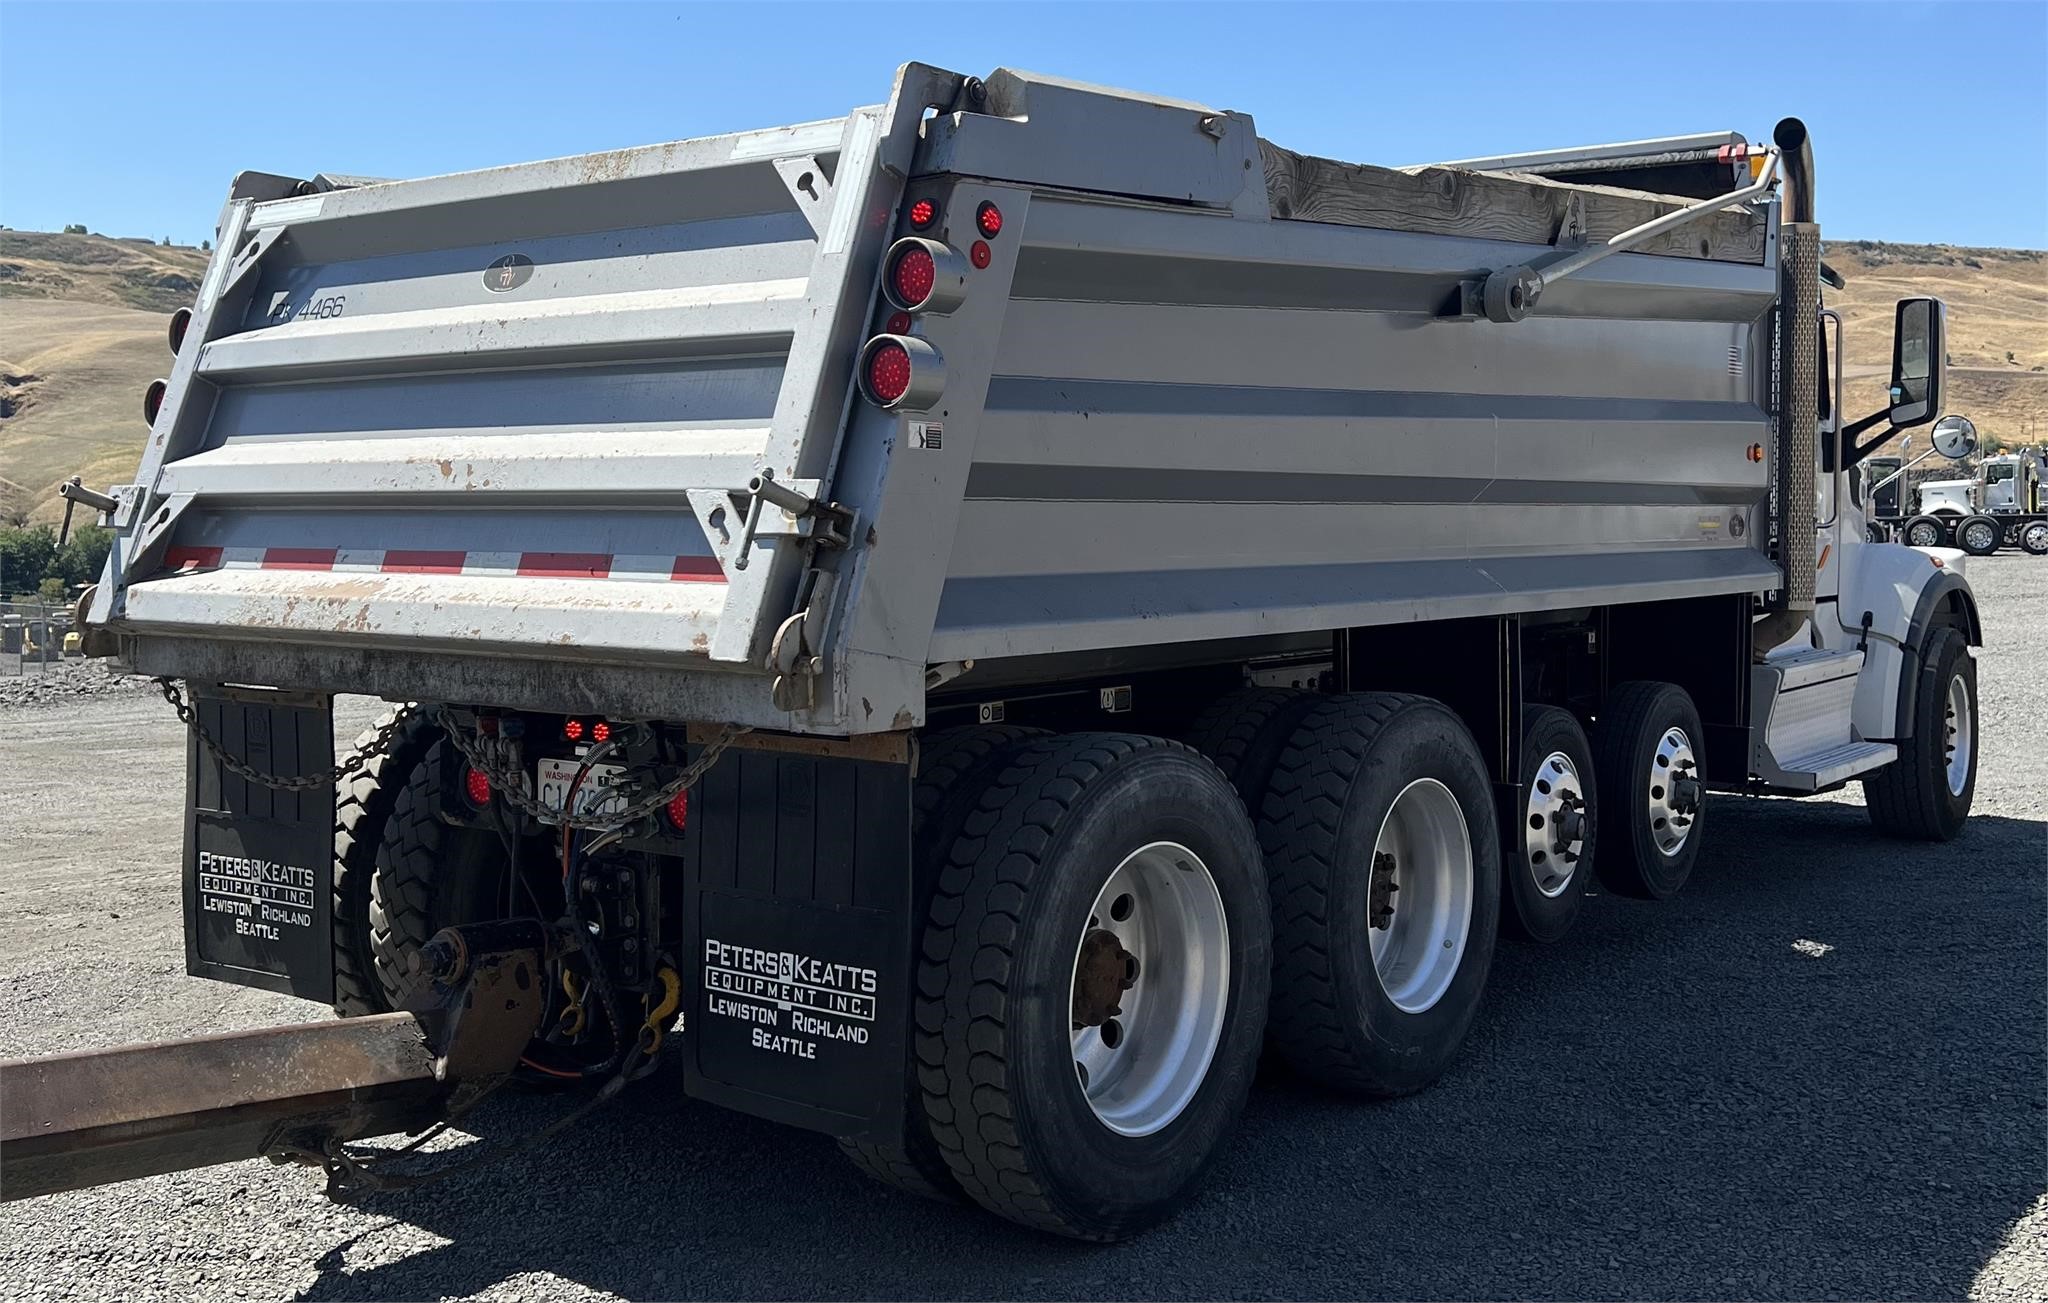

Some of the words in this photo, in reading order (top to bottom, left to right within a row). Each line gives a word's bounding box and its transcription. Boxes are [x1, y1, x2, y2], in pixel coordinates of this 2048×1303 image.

[299, 296, 345, 320] 4466
[545, 770, 593, 784] WASHINON
[204, 877, 277, 898] EQUIPMENT
[285, 890, 310, 905] INC.
[203, 894, 252, 917] LEWISTON
[261, 904, 311, 927] RICHLAND
[236, 918, 280, 941] SEATTLE
[711, 972, 817, 1005] EQUIPMENT
[829, 994, 868, 1016] INC.
[709, 994, 777, 1026] LEWISTON
[792, 1011, 869, 1044] RICHLAND
[752, 1027, 817, 1059] SEATTLE
